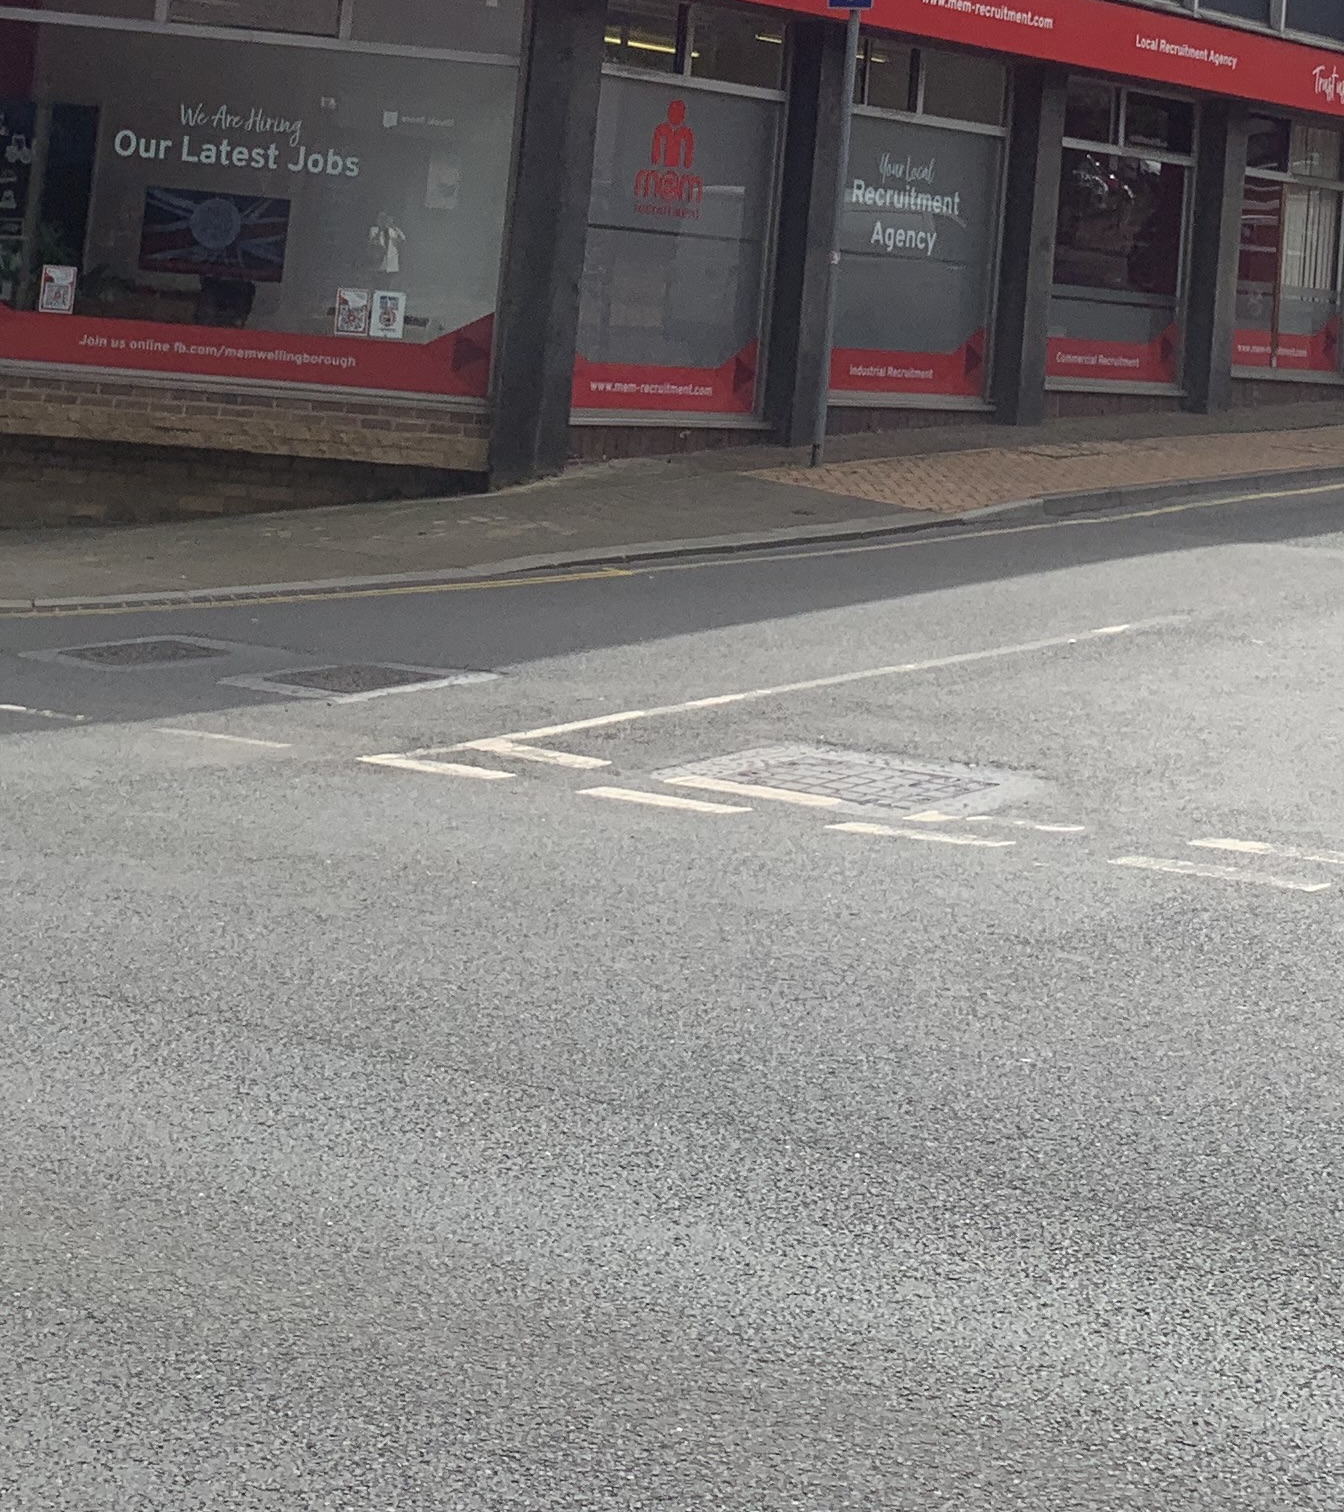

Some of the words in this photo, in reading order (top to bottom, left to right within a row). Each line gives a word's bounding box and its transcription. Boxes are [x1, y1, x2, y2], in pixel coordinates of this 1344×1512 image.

[1135, 34, 1158, 52] Local
[1159, 39, 1208, 62] Recruitment
[1208, 50, 1238, 70] Agency
[1312, 64, 1339, 102] Trust
[179, 103, 208, 126] We
[211, 104, 243, 130] Are
[244, 106, 303, 147] Hiring
[113, 129, 172, 160] Our
[181, 135, 279, 170] Latest
[287, 145, 360, 178] Jobs
[879, 152, 905, 184] Your
[905, 155, 936, 185] Local
[851, 179, 961, 216] Recruitment
[870, 220, 938, 257] Agency
[79, 334, 107, 347] Join
[110, 339, 126, 349] us
[129, 339, 170, 352] online
[1055, 351, 1098, 365] Commercial
[1098, 355, 1140, 368] Recruitment
[589, 381, 714, 397] www.mem-recruitment.com
[849, 364, 887, 377] Industrial
[887, 366, 934, 379] Recruitment
